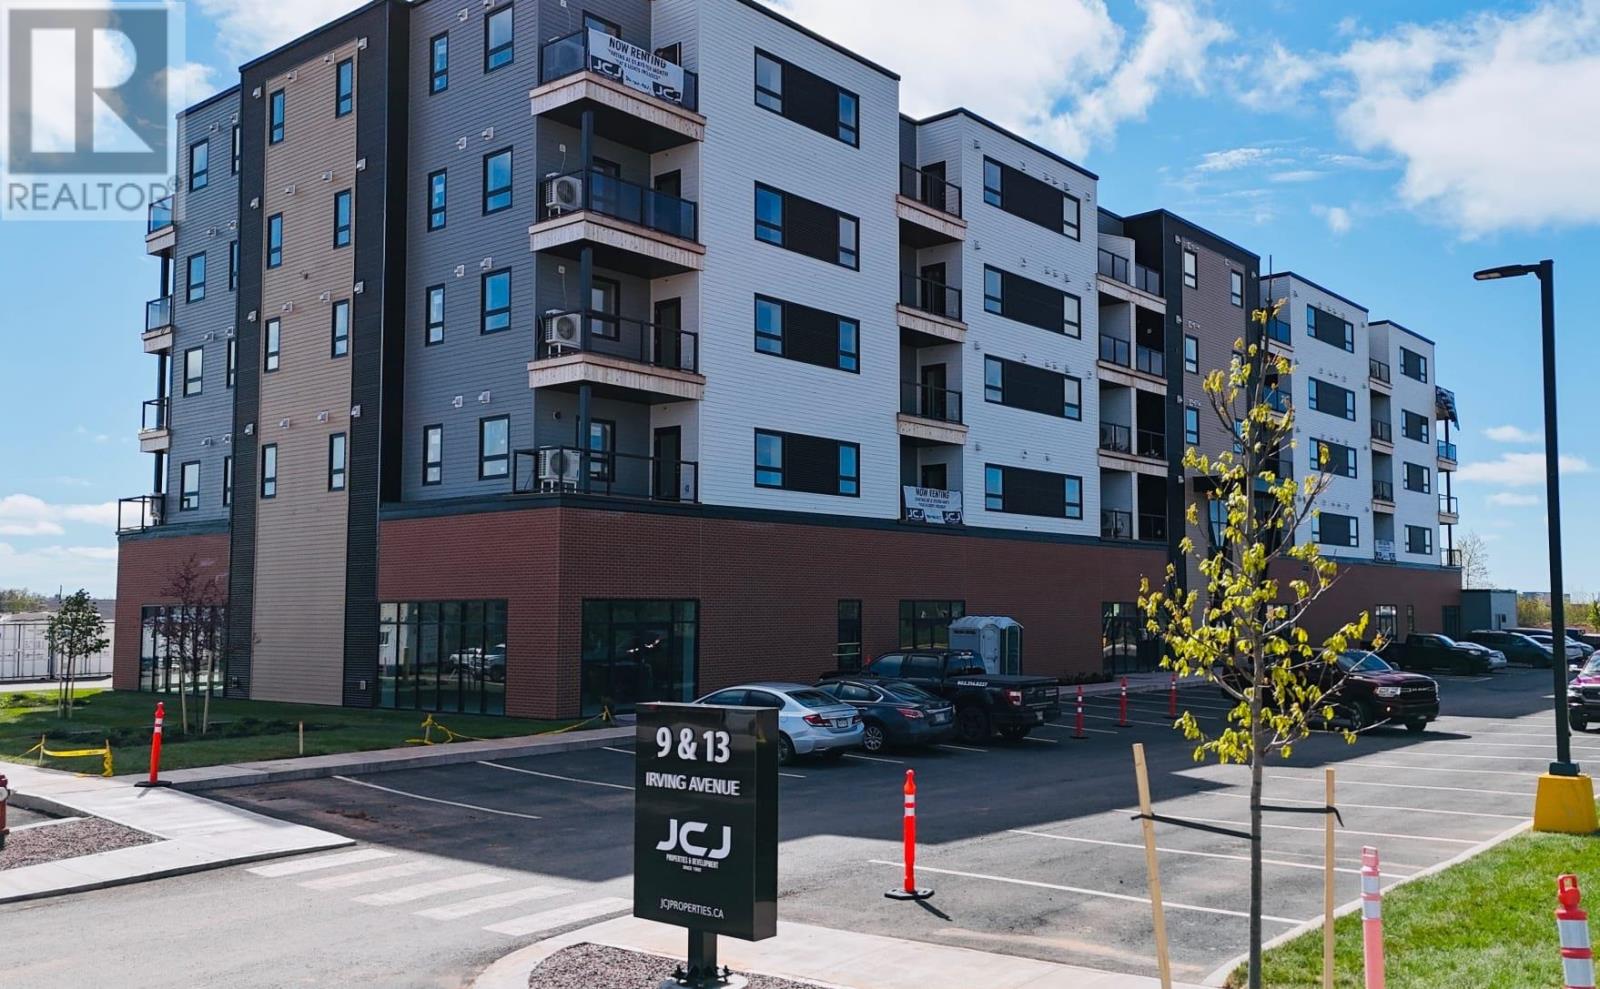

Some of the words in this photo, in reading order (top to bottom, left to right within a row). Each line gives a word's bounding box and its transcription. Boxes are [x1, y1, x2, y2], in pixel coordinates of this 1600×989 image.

[608, 37, 629, 54] NOW
[630, 46, 667, 69] RENTING
[593, 59, 624, 78] JCJ
[656, 726, 673, 758] 9
[677, 727, 698, 761] &
[703, 730, 731, 763] 13
[645, 771, 687, 790] IRVING
[688, 776, 741, 796] AVENUE
[656, 818, 732, 860] JCJ
[660, 898, 725, 919] JCJPROPERTIES.CA
